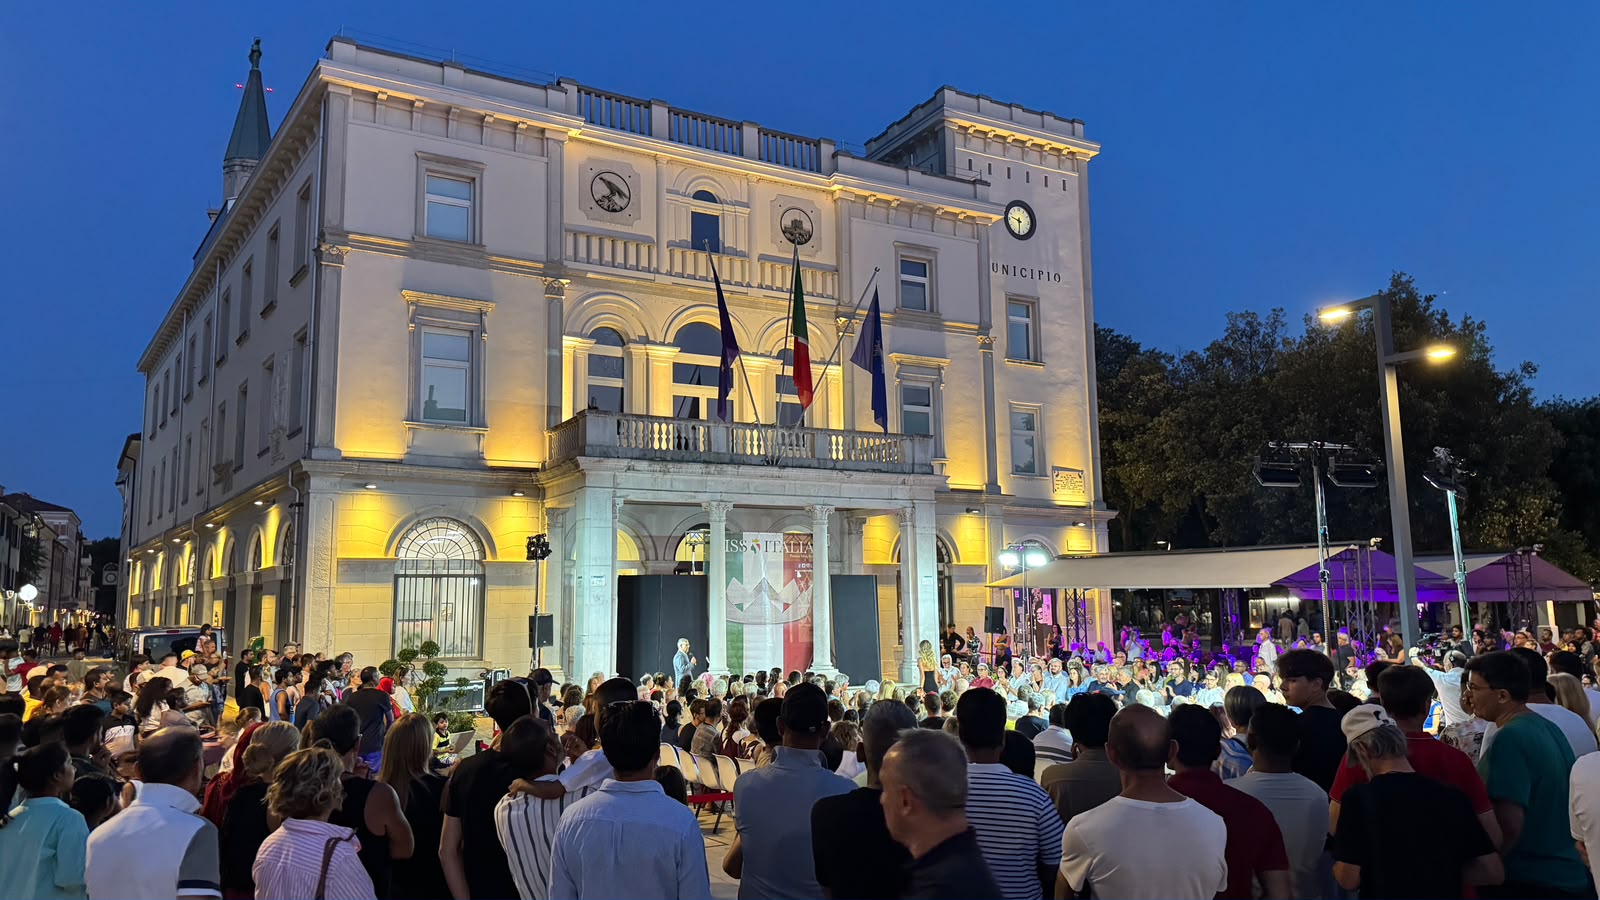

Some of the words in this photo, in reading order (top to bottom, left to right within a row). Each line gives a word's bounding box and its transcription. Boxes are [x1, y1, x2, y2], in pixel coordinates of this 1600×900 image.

[991, 262, 1061, 283] UNICIPIO
[725, 539, 748, 552] ISS
[765, 540, 813, 554] ITALIA
